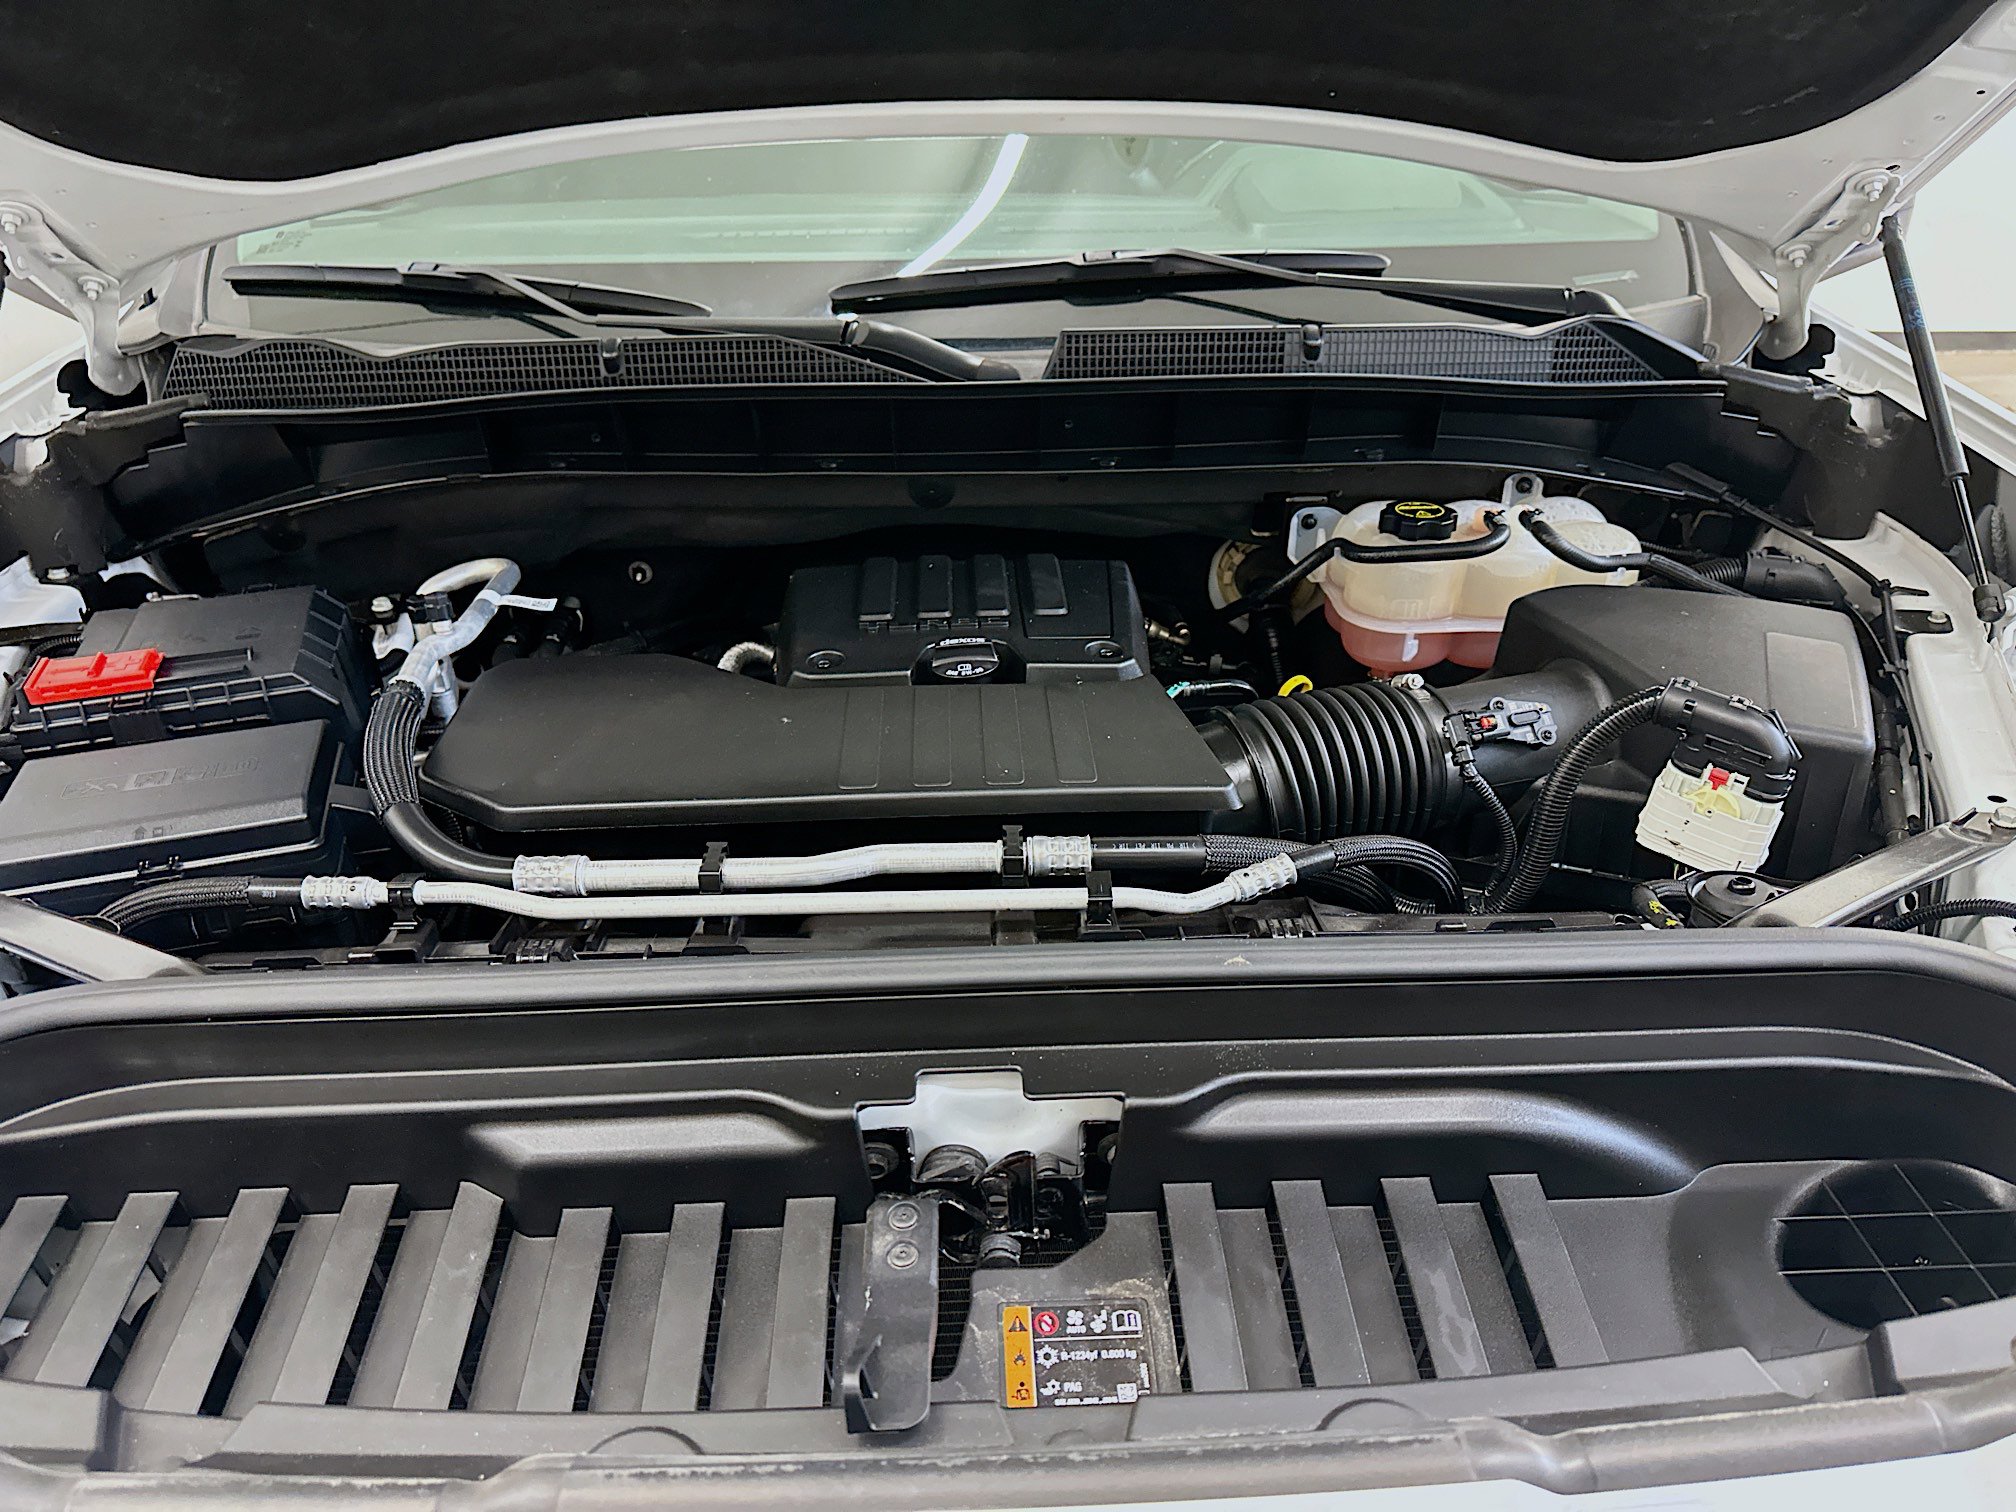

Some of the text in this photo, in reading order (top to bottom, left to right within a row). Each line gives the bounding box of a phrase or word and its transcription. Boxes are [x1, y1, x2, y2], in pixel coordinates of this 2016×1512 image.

[1060, 1350, 1098, 1361] R-1234yf
[1125, 1348, 1137, 1360] kg
[1063, 1381, 1083, 1392] PAG
